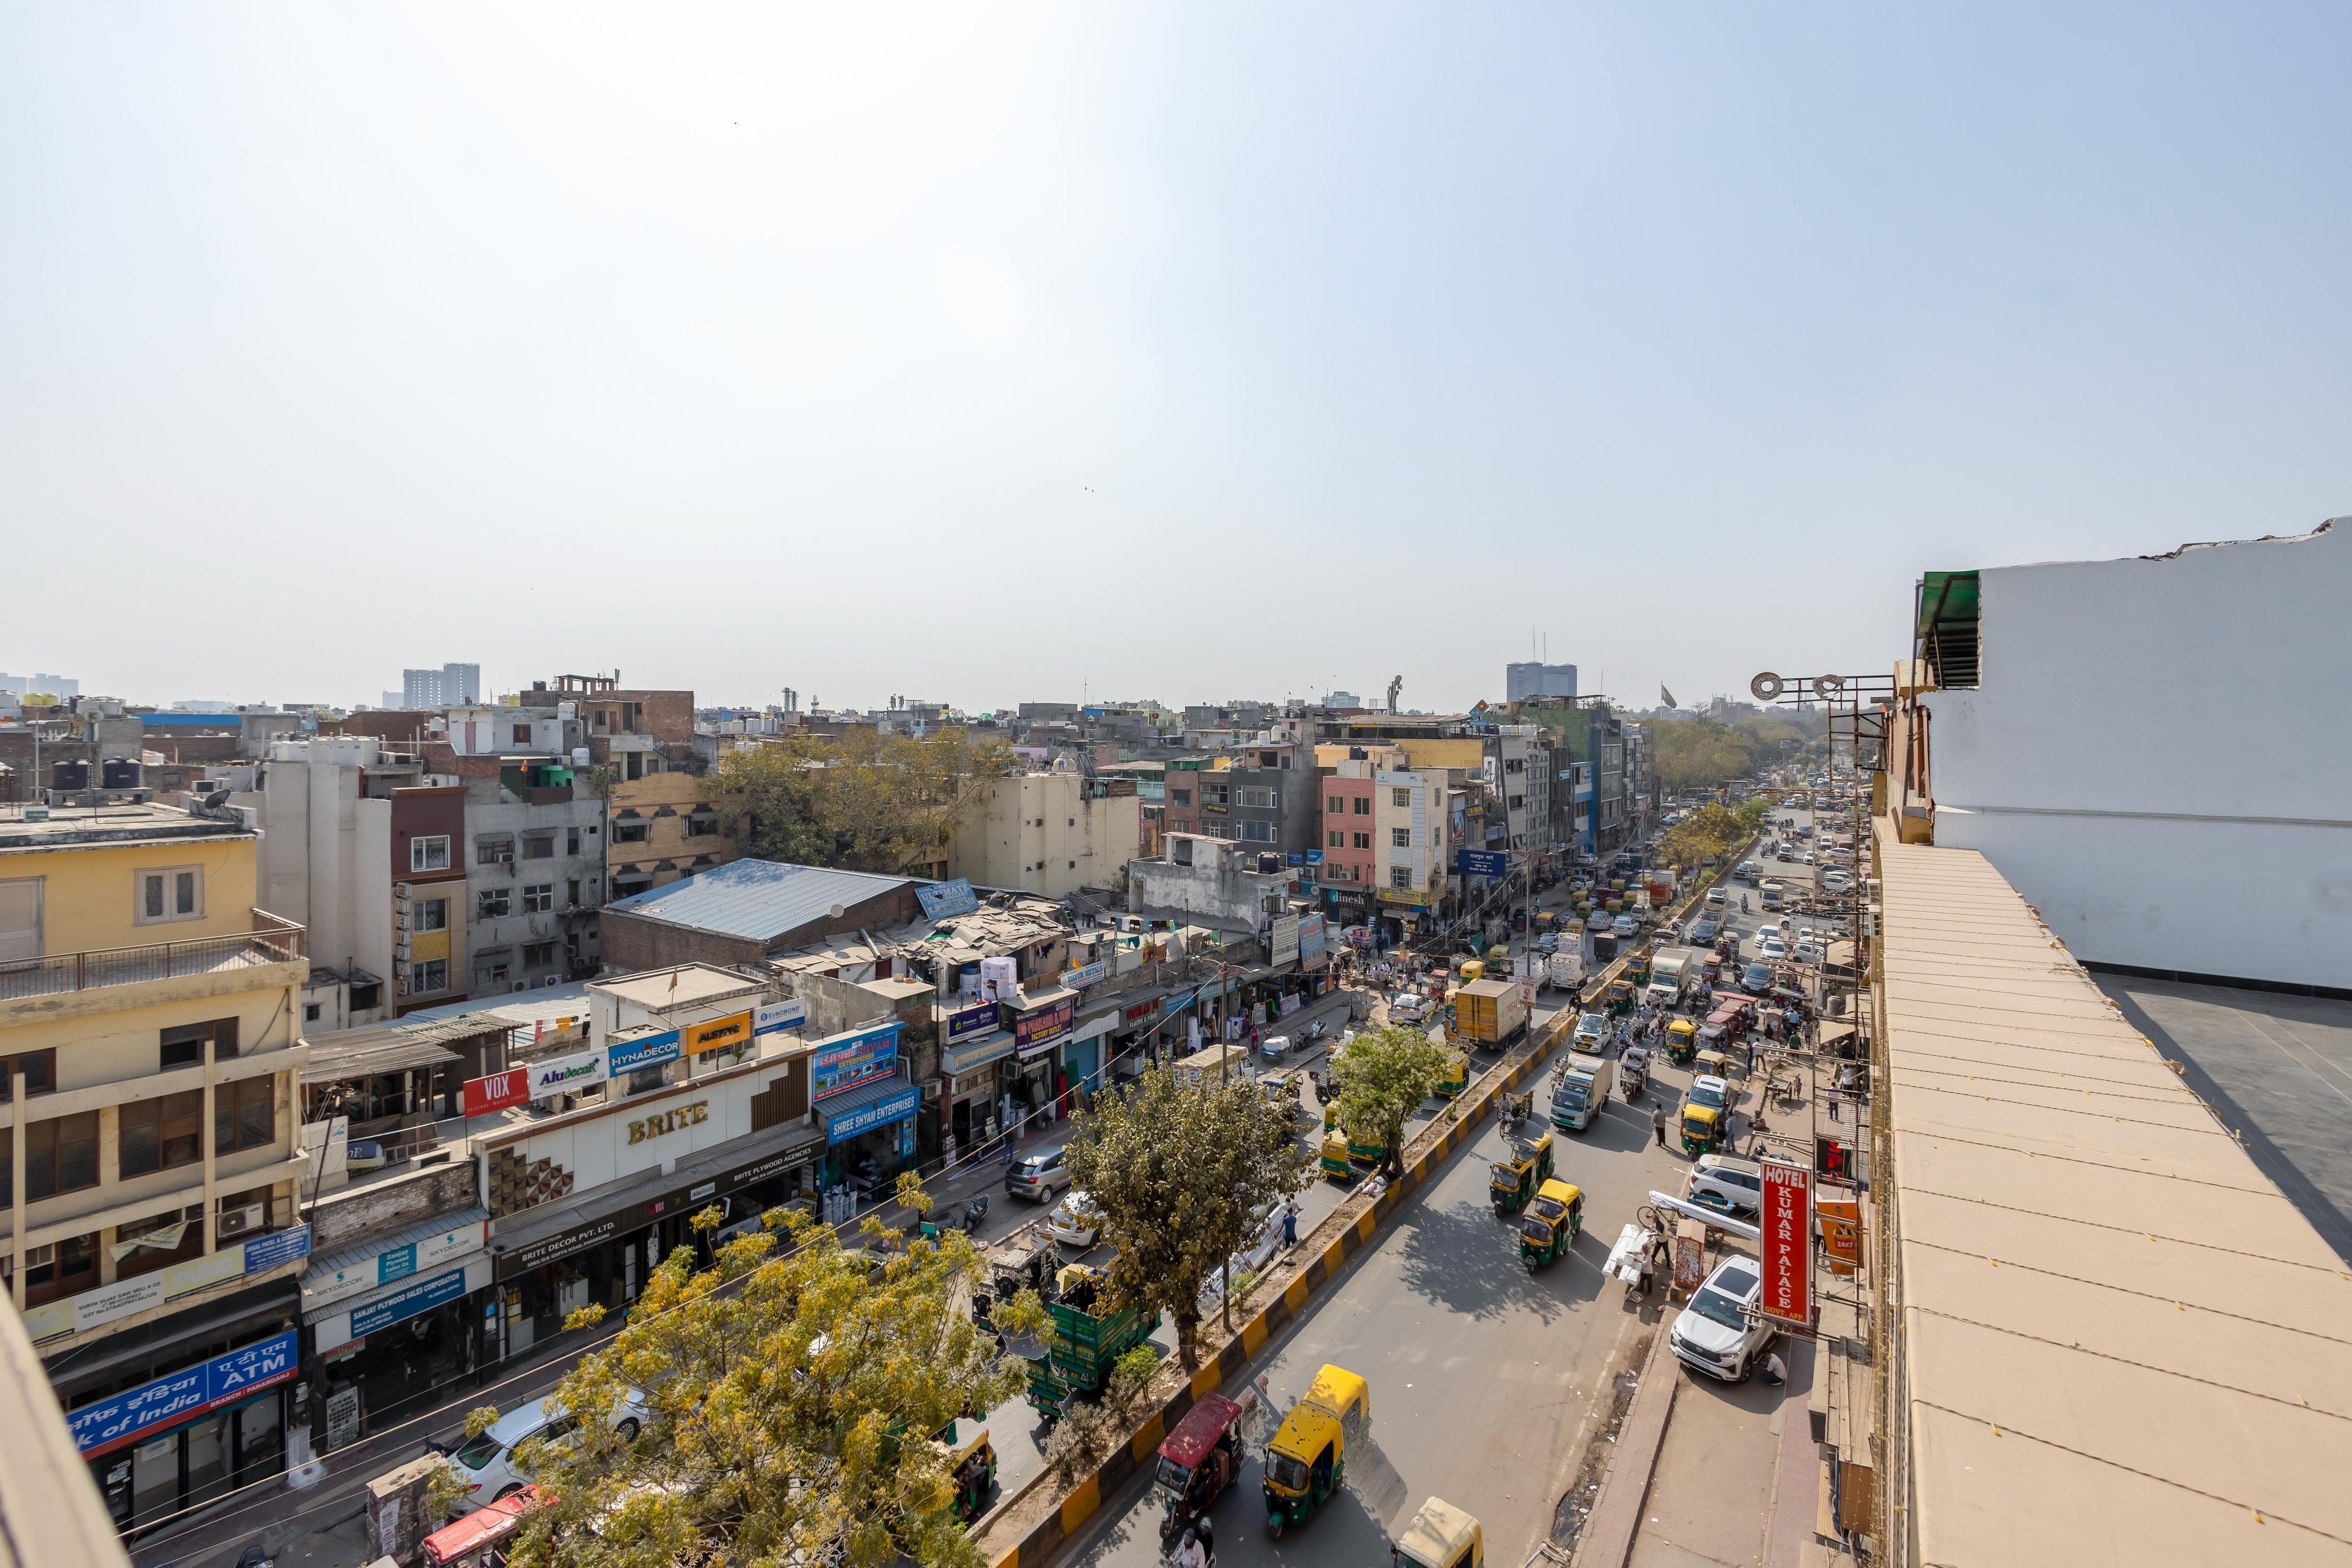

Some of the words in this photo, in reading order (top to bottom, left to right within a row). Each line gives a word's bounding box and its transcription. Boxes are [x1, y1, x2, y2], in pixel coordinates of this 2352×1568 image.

[921, 884, 969, 900] ULTIMATE
[1333, 890, 1364, 905] dinesh
[1067, 972, 1084, 983] MAYUR
[1085, 965, 1103, 977] METALS
[768, 1006, 800, 1018] EUROBOND
[1129, 1019, 1144, 1028] PLASTIC
[1147, 1013, 1158, 1022] FIBRE
[1028, 1013, 1054, 1034] PRAKASH
[1031, 1029, 1048, 1041] FACTORY
[1048, 1024, 1062, 1035] OUTLET
[820, 1049, 856, 1067] SHREE
[857, 1039, 891, 1056] SHYAM
[977, 1041, 1013, 1058] ENTERPRISES
[838, 1052, 874, 1069] ENTERPRISES
[485, 1075, 510, 1100] VOX
[557, 1077, 580, 1087] Composite
[468, 1103, 489, 1112] CEILINGS
[834, 1117, 854, 1136] SHREE
[855, 1110, 876, 1127] SHYAM
[877, 1096, 915, 1120] ENTERPRISES
[628, 1100, 709, 1145] BRITE
[734, 1169, 752, 1182] BRITE
[753, 1158, 783, 1174] PLYWOOD
[784, 1147, 812, 1164] AGENCIES
[766, 1167, 778, 1176] GUPTA
[1765, 1166, 1805, 1189] HOTEL
[655, 1201, 665, 1213] VOX
[1777, 1186, 1793, 1241] KUMAR
[246, 1244, 261, 1253] JUGAL
[262, 1239, 276, 1248] PATEL
[281, 1229, 309, 1242] ASSOCIATES
[429, 1239, 470, 1257] SKYDECOR
[522, 1247, 546, 1262] BRITE
[548, 1236, 577, 1252] DECOR
[579, 1229, 596, 1241] PVT.
[597, 1222, 615, 1233] LTD.
[551, 1249, 568, 1259] GUPTA
[583, 1232, 610, 1247] PAHARGANJ
[386, 1249, 409, 1261] Sanjay
[386, 1255, 409, 1267] Plywood
[385, 1264, 400, 1274] Sales
[1778, 1244, 1792, 1309] PALACE
[316, 1276, 363, 1297] SKYDECOR
[353, 1305, 377, 1320] SANJAY
[378, 1293, 406, 1310] PLYWOOD
[406, 1287, 423, 1299] SALES
[424, 1272, 460, 1292] CORPORATION
[78, 1300, 98, 1310] SURYA
[100, 1295, 116, 1306] VIJAY
[118, 1290, 131, 1299] SAW
[1765, 1306, 1787, 1317] GOVT.
[1789, 1312, 1805, 1321] APP.
[222, 1353, 285, 1390] ATM
[210, 1391, 241, 1408] BRANCH
[247, 1372, 290, 1393] PAHARGANJ
[101, 1416, 132, 1438] of
[137, 1392, 201, 1425] India
